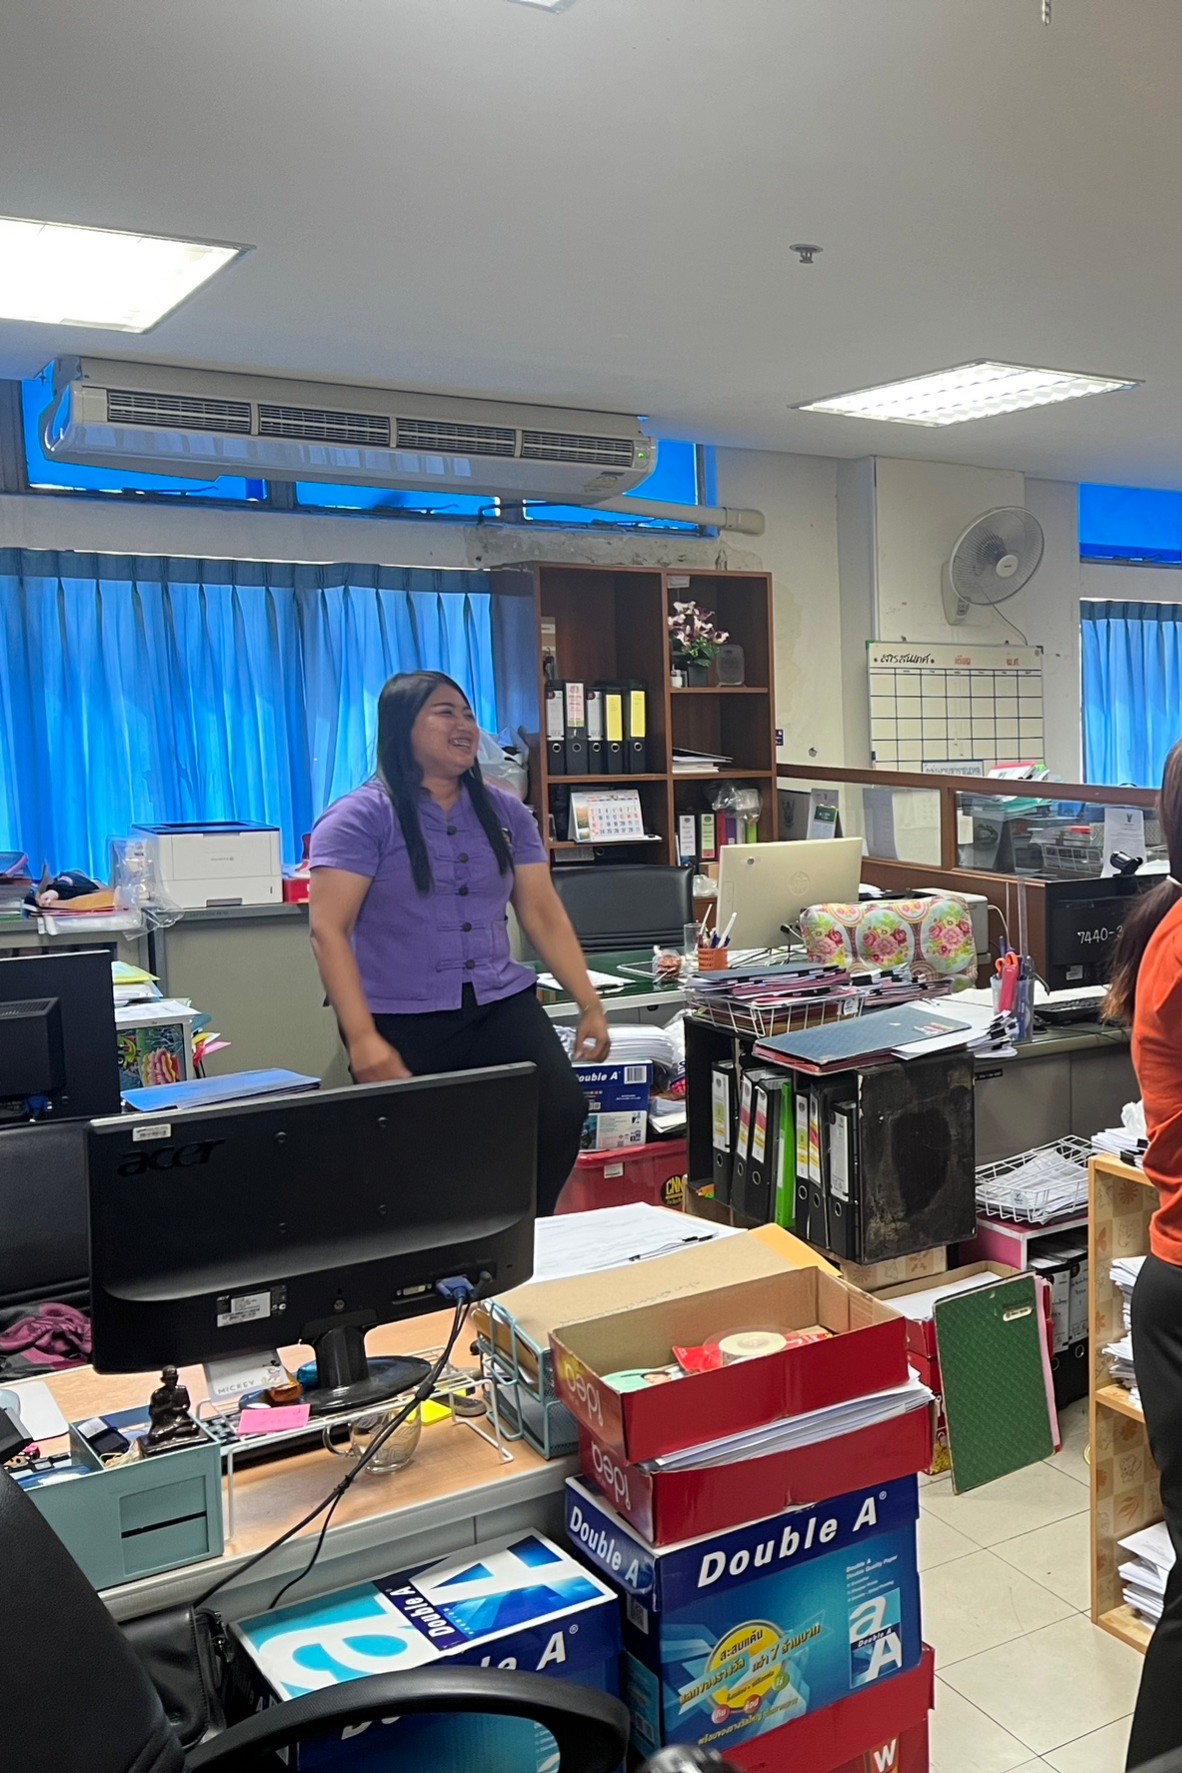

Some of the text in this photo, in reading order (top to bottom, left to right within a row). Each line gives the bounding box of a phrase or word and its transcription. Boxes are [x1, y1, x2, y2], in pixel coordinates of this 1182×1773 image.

[577, 1071, 607, 1083] ouble
[117, 1139, 225, 1177] acer
[217, 1379, 255, 1396] MICKEY
[569, 1506, 639, 1587] Double A
[697, 1496, 878, 1589] Double A
[390, 1586, 456, 1637] Double A
[536, 1631, 566, 1671] A
[771, 1644, 780, 1661] 7
